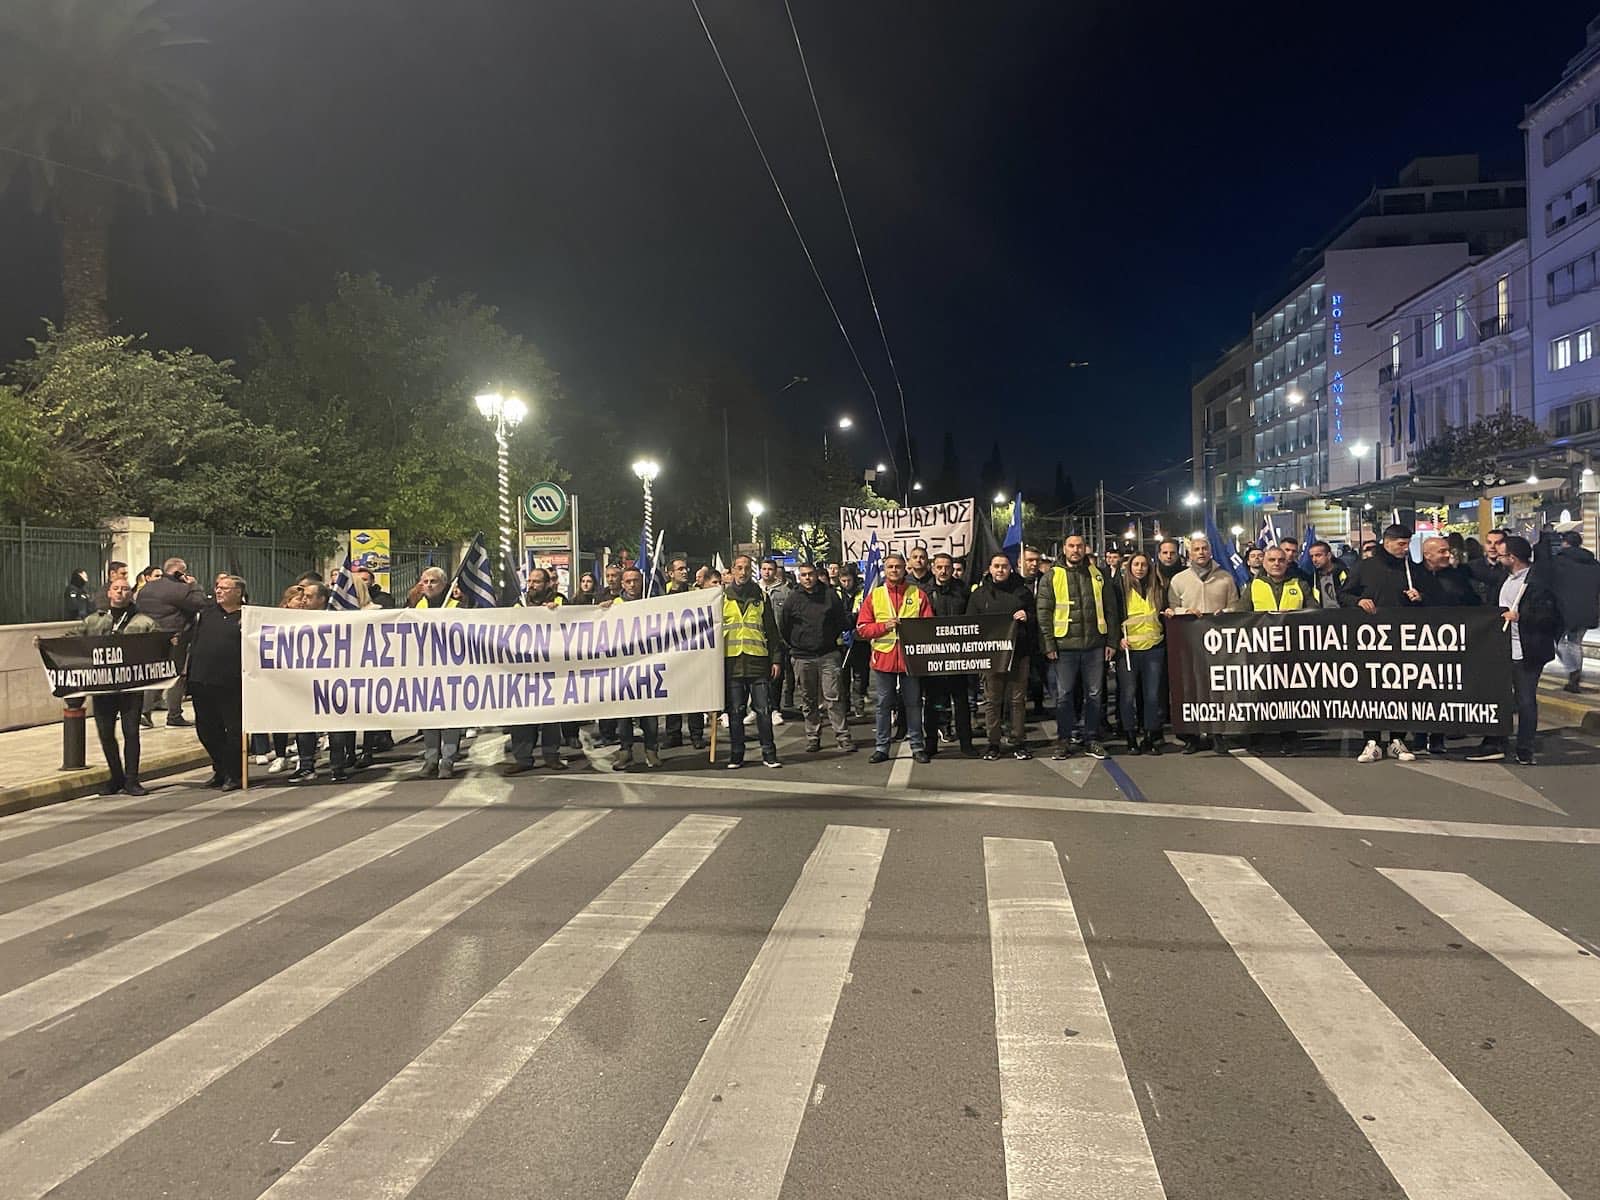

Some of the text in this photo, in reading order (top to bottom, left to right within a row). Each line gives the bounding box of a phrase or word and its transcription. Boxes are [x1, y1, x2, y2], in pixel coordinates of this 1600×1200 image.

[1333, 371, 1344, 443] AMALIA
[260, 605, 716, 669] ΕΝΩΣΗ ΑΣΤΥΝΟΜΙΚΩΝ ΥΠΑΛΛΗΛΩΝ
[935, 624, 980, 636] ΣΕΒΑΣΤΕΙΤΕ
[1203, 623, 1466, 655] ΦΤΑΝΕΙ ΠΙΑ! ΩΣ ΕΔΩ!
[92, 647, 123, 665] ΩΣ ΕΔΩ
[904, 640, 1013, 655] ΤΟ ΕΠΙΚΙΝΔΥΝΟ ΛΕΙΤΟΥΡΓΗΜΑ
[57, 670, 65, 686] Η
[65, 667, 114, 687] ΑΣΤΥΝΟΜΙΑ
[114, 666, 131, 683] ΑΠΟ
[133, 664, 144, 681] ΤΑ
[145, 660, 177, 679] ΓΗΠΕΔΑ
[927, 659, 992, 672] ΠΟΥ ΕΠΙΤΕΛΟΥΜΕ
[1210, 662, 1463, 691] ΕΠΙΚΙΝΔΥΝΟ ΤΩΡΑ!!!
[313, 663, 668, 715] ΝΟΤΙΟΑΝΑΤΟΛΙΚΗΣ ΑΤΤΙΚΗΣ
[1182, 700, 1499, 724] ΕΝΩΣΗ ΑΣΤΥΝΟΜΙΚΩΝ ΥΠΑΛΛΗΛΩΝ Ν/Α ΑΤΤΙΚΗΣ
